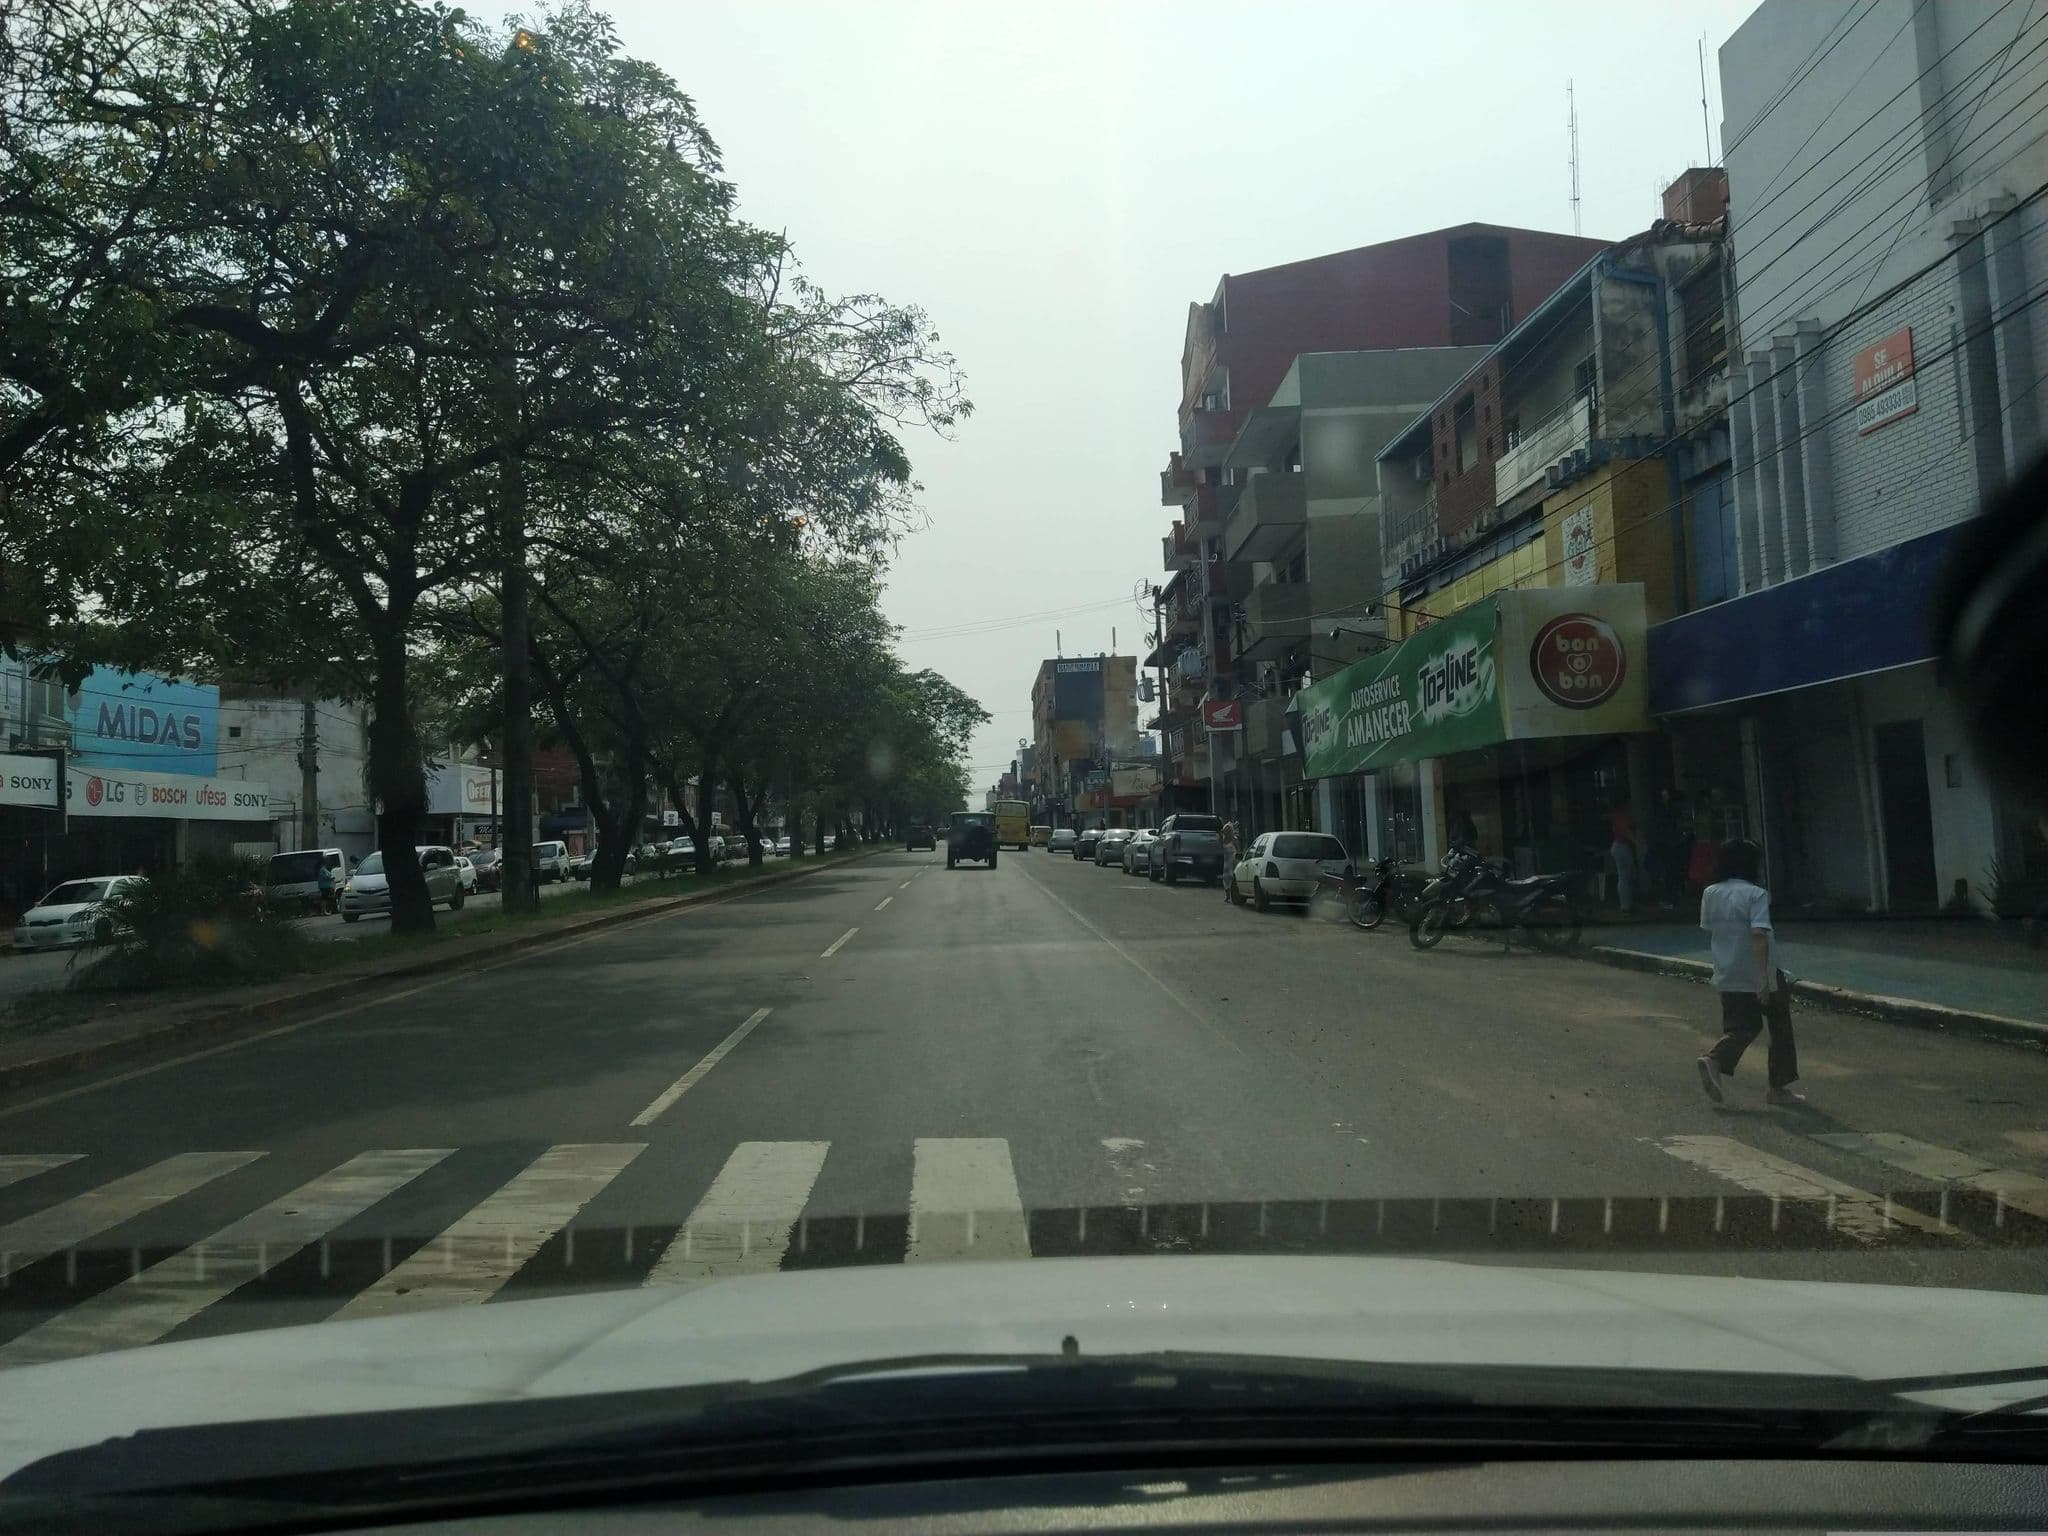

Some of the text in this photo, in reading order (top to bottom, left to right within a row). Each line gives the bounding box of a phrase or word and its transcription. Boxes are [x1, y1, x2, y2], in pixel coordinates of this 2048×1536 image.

[1874, 349, 1888, 369] SE
[1862, 362, 1904, 395] ALQUILA
[1556, 633, 1600, 653] bon
[1351, 674, 1401, 711] AUTOSERVICE
[1559, 671, 1602, 689] bon
[96, 701, 201, 750] MIDAS
[1347, 700, 1412, 748] AMANECER
[11, 776, 52, 790] SONY
[106, 782, 268, 807] LG BOSCH ufesa SONY
